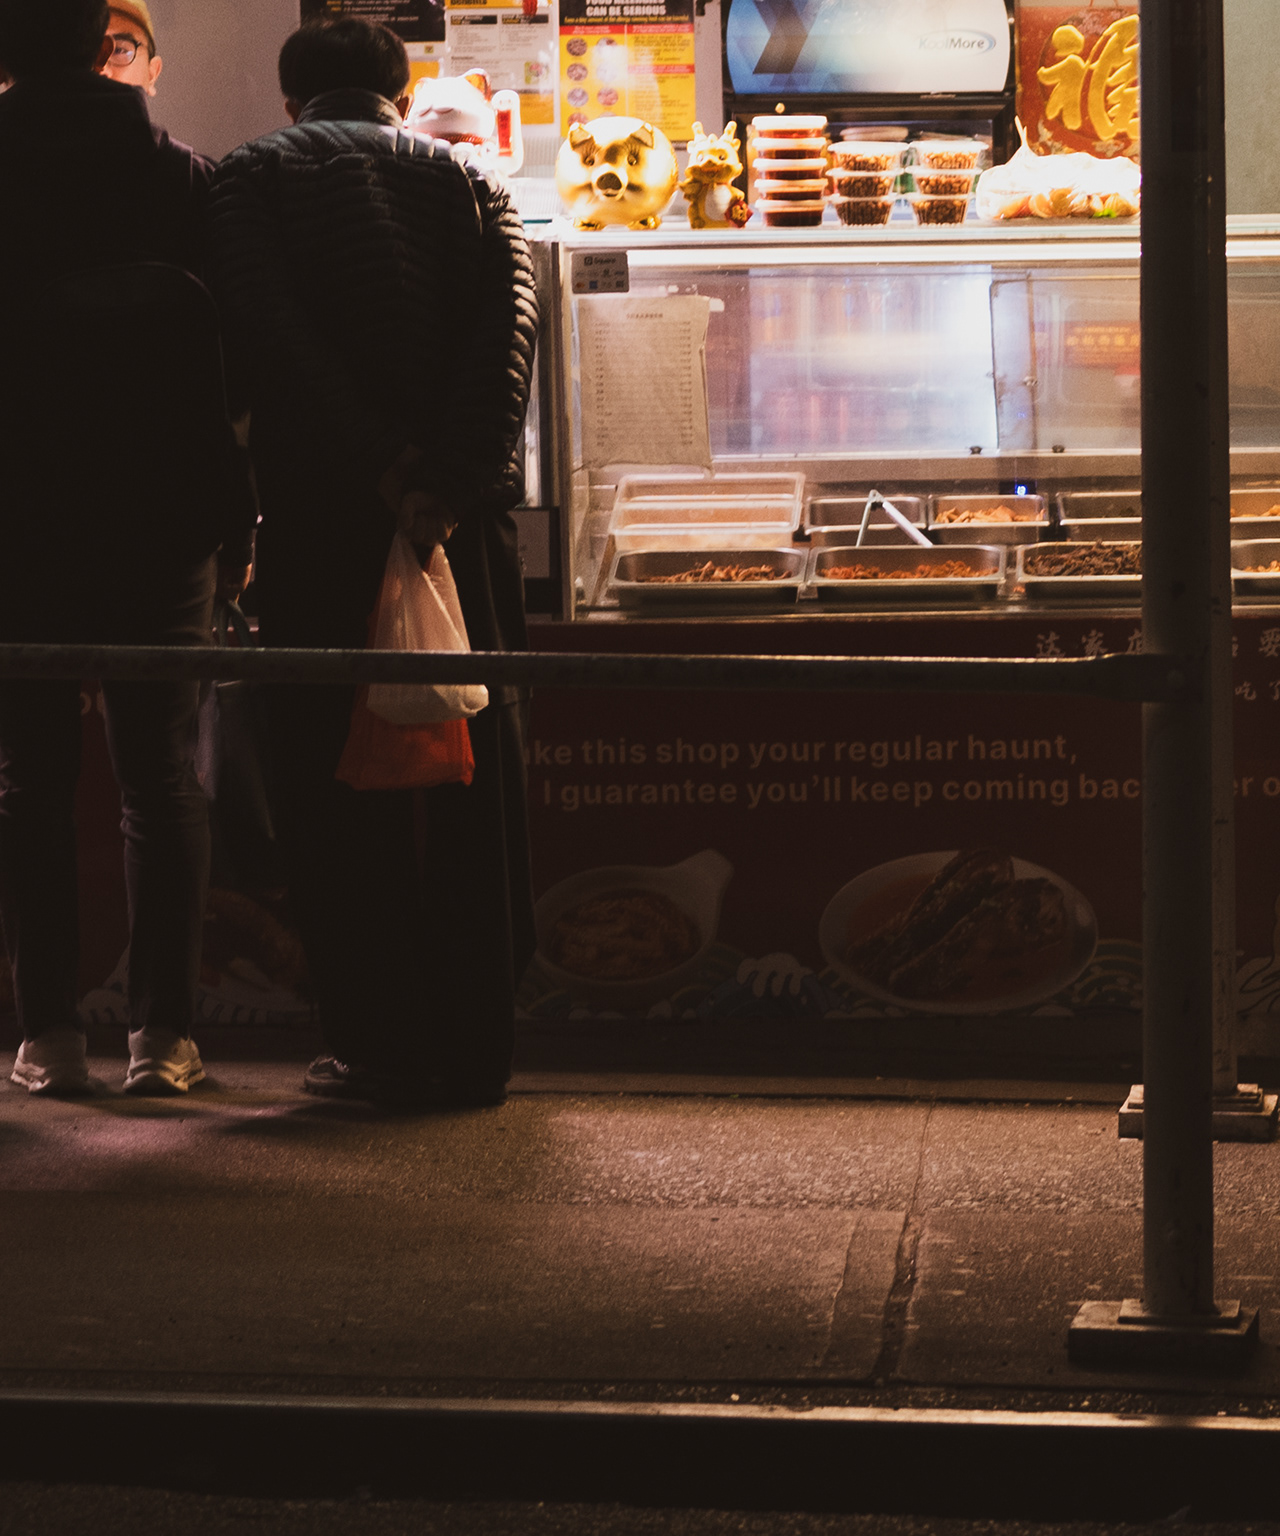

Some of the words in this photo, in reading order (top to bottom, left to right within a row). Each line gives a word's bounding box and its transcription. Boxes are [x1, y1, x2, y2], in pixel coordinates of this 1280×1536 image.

[586, 6, 608, 17] CAN
[623, 5, 667, 16] SERIOUS
[581, 738, 648, 765] this
[655, 738, 740, 769] shop
[748, 740, 826, 769] your
[833, 734, 959, 768] regular
[967, 733, 1078, 765] haunt,
[560, 779, 738, 811] guarantee
[850, 774, 933, 808] keep
[941, 772, 1070, 807] coming
[1078, 772, 1142, 799] bac
